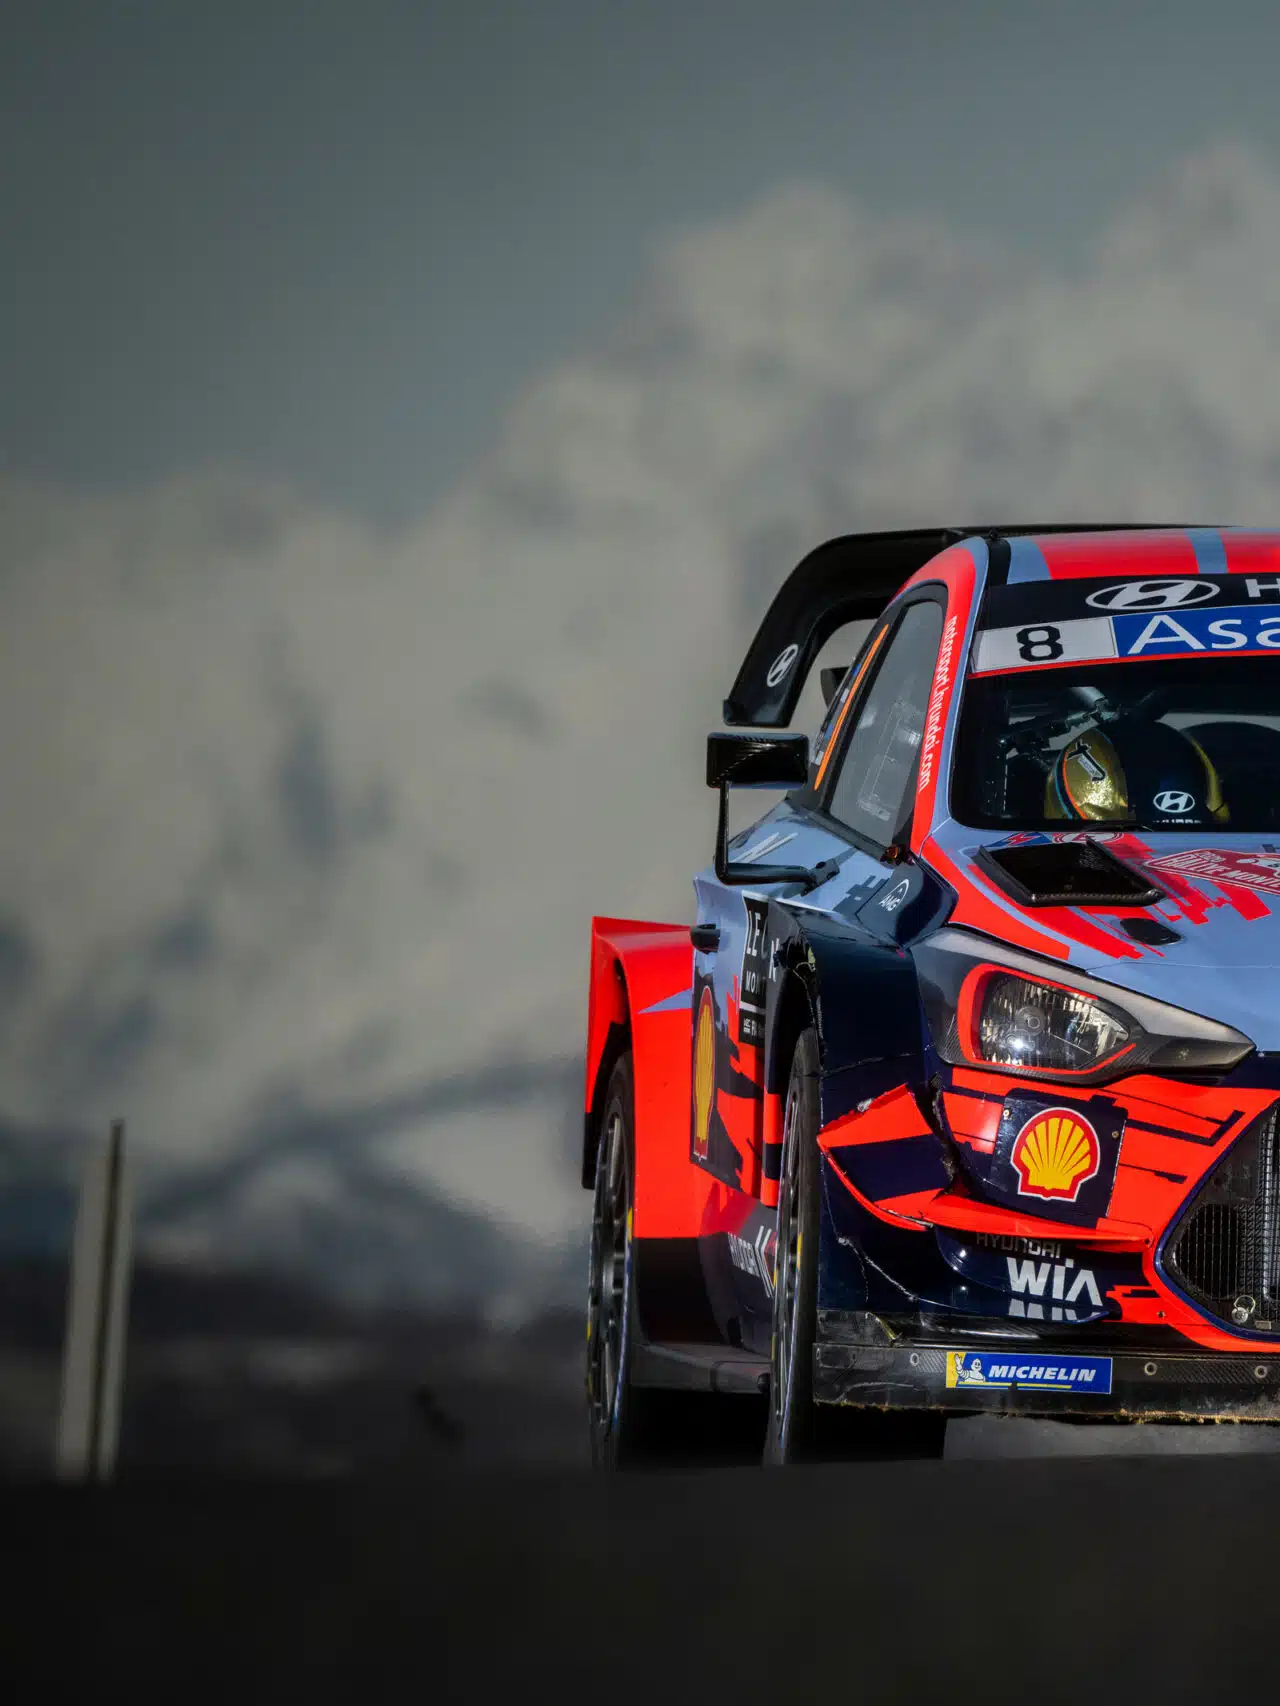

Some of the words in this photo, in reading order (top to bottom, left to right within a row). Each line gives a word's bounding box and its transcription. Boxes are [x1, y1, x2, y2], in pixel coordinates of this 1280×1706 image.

[1015, 625, 1065, 662] 8
[918, 614, 958, 794] motorsport.hyundai.com
[975, 1232, 1062, 1259] HYUNDAI
[1005, 1256, 1104, 1307] WIA
[988, 1363, 1097, 1383] MICHELIN
